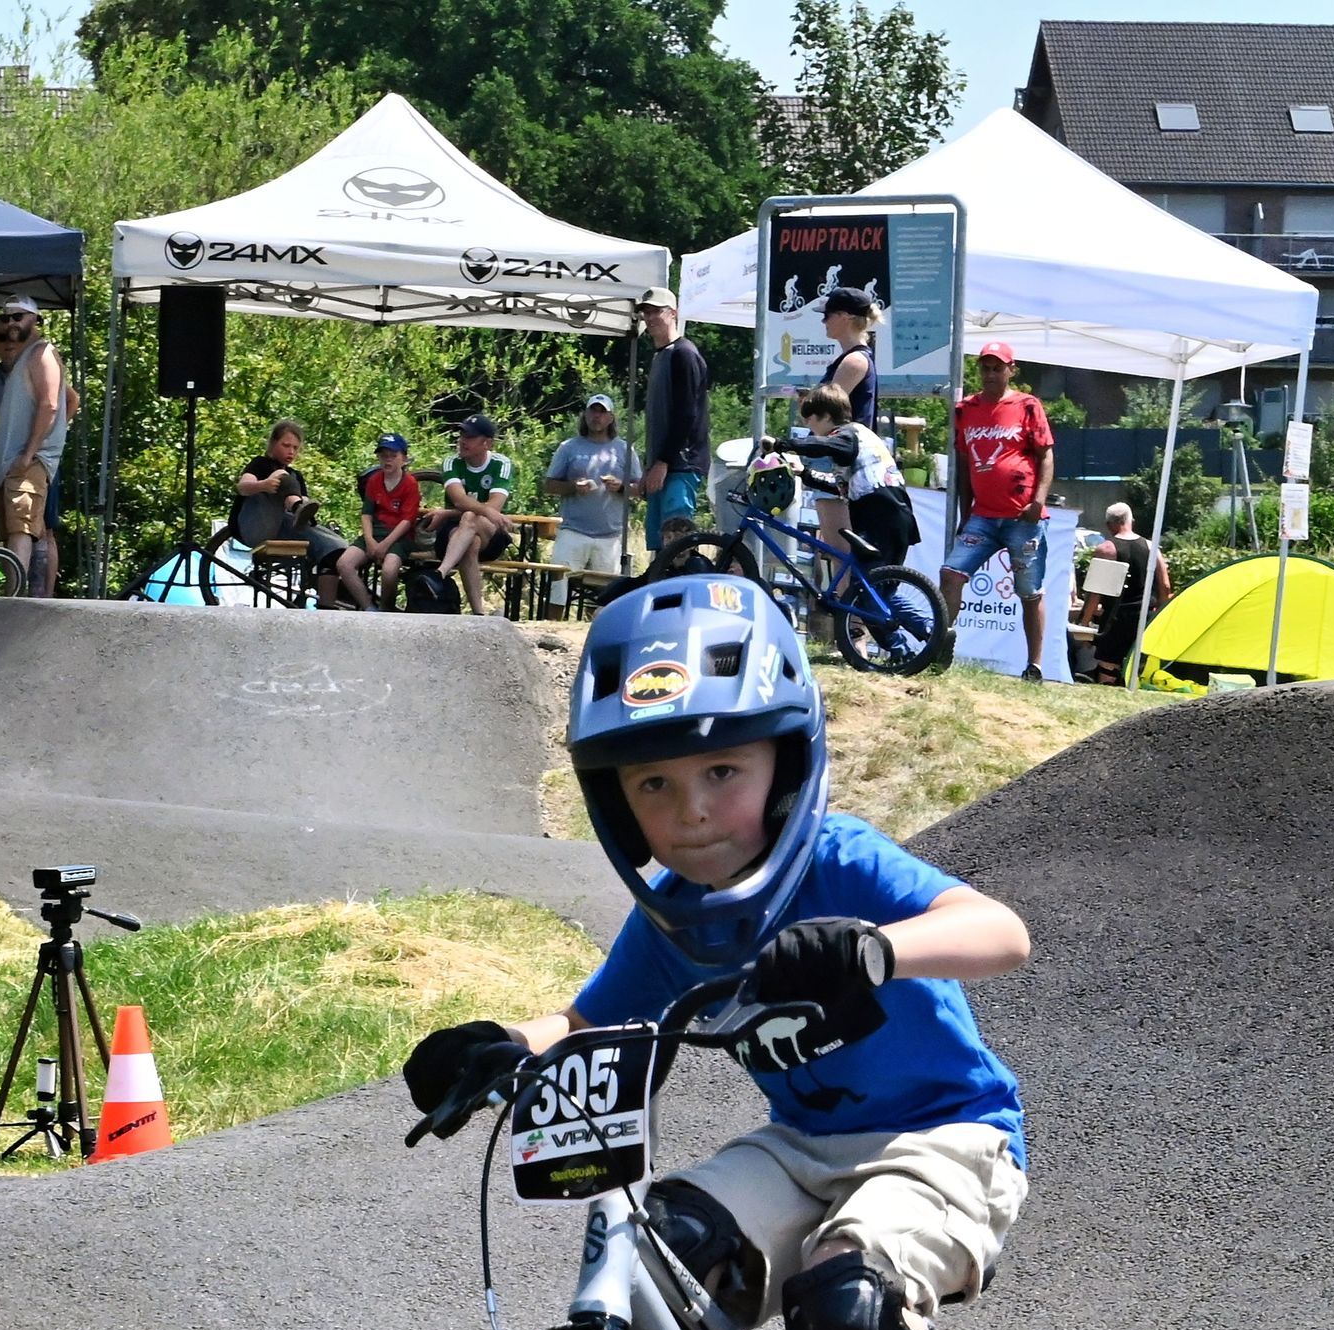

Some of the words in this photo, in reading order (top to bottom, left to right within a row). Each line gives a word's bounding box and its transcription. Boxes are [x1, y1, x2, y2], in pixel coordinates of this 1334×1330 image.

[779, 225, 885, 252] PUMPTRACK
[207, 241, 328, 266] 24MX
[501, 257, 622, 283] 24MX
[958, 599, 1017, 616] ordeifel
[953, 616, 1016, 632] urismus
[531, 1047, 621, 1126] 305
